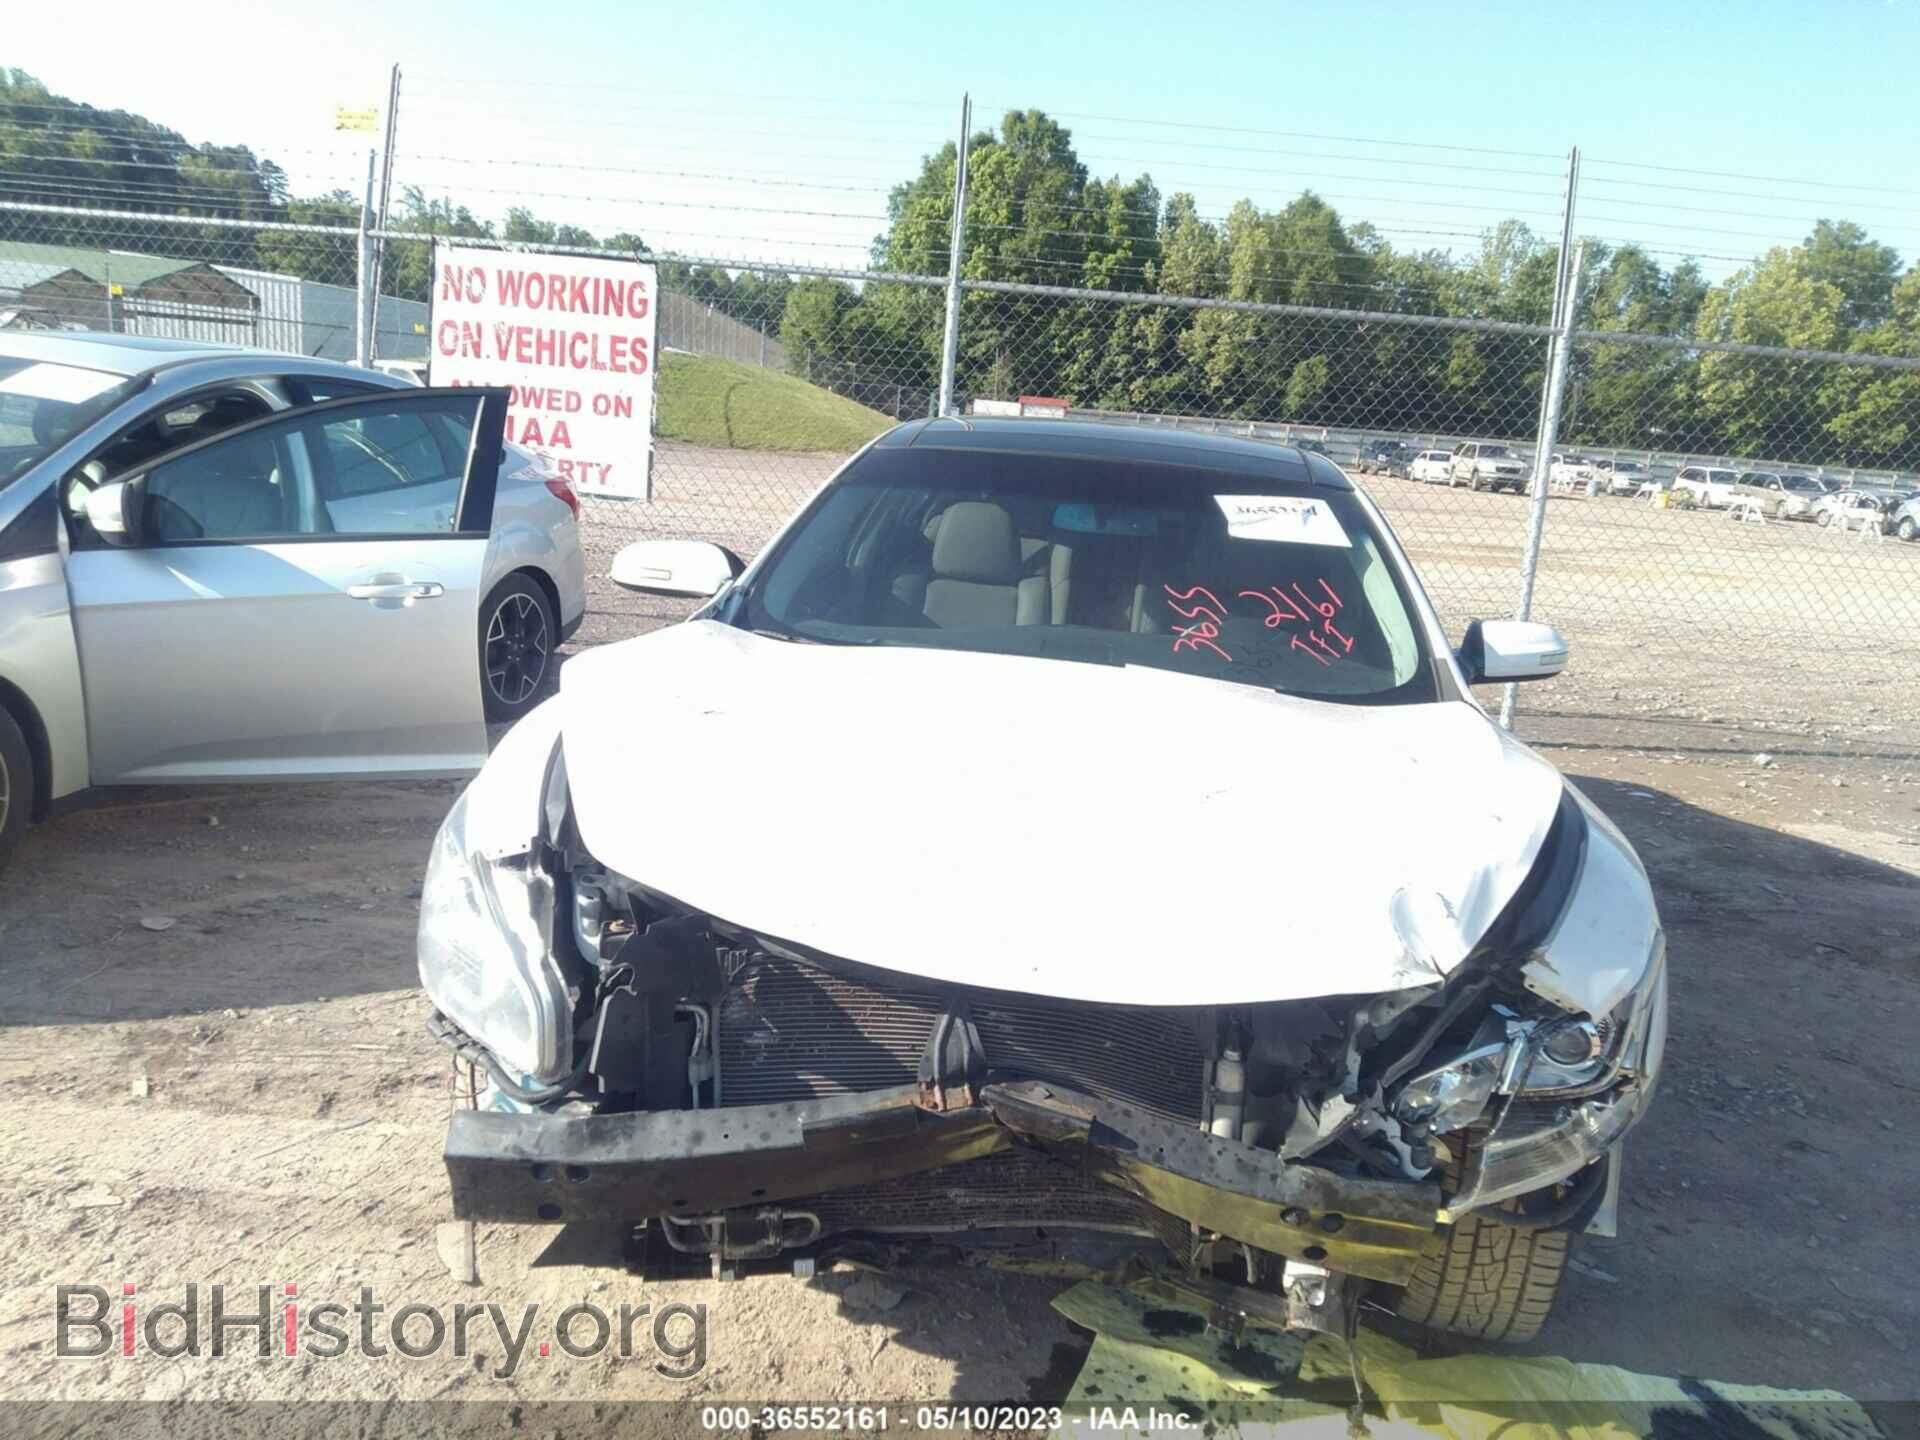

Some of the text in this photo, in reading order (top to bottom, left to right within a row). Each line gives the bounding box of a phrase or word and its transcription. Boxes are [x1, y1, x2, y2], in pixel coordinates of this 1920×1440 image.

[442, 264, 649, 319] NO WORKING
[438, 319, 649, 375] ON VEHICLES
[592, 393, 633, 418] ON
[505, 415, 572, 449] IAA
[1238, 577, 1344, 628] 2161
